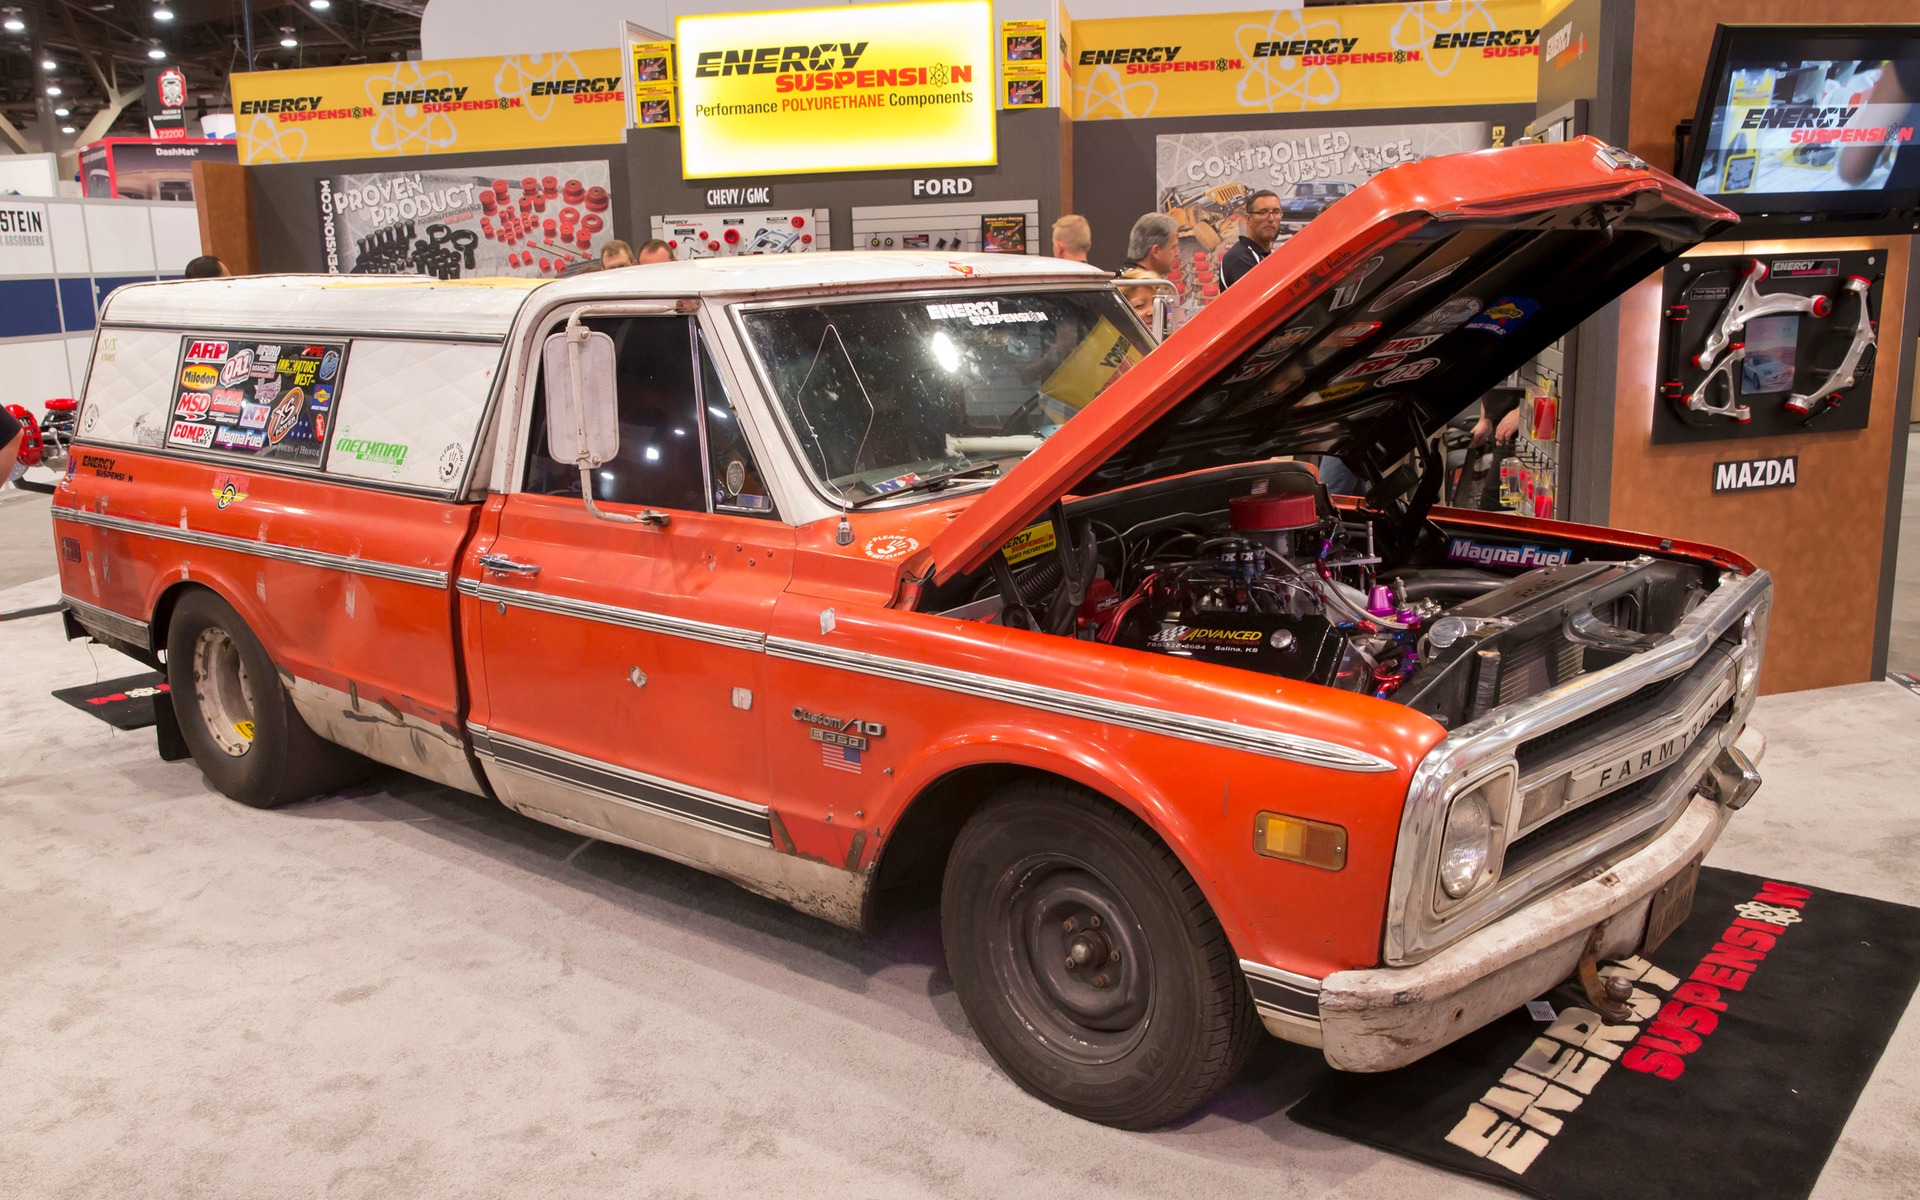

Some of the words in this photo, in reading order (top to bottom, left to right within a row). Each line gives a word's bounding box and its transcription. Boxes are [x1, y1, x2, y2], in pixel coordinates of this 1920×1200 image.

[1252, 37, 1358, 57] ENERGY
[1433, 29, 1540, 49] ENERGY
[695, 42, 869, 78] ENERGY
[1079, 46, 1182, 65] ENERGY
[382, 87, 469, 105] ENERGY
[531, 77, 621, 96] ENERGY
[240, 96, 322, 115] ENERGY
[696, 101, 778, 117] Performance
[782, 94, 885, 112] POLYURETHANE
[889, 90, 973, 108] Components
[1741, 107, 1859, 129] ENERGY
[158, 129, 185, 139] 23200
[1187, 130, 1352, 182] CONTROLLED
[1269, 139, 1415, 188] SUBSTANCE
[333, 173, 424, 215] PROVEN
[707, 188, 740, 206] CHEVY
[746, 187, 770, 204] GMC
[913, 178, 973, 196] FORD
[370, 183, 474, 228] PRODUCT
[4, 234, 45, 247] ABSORBERS
[1773, 261, 1815, 272] ENERGY
[926, 301, 998, 320] ENERGY
[187, 342, 228, 359] ARP
[183, 370, 216, 385] Milodon
[294, 373, 314, 386] WEST
[177, 392, 211, 413] MSD
[173, 423, 205, 440] COMP
[217, 428, 265, 448] MagnaFuel
[336, 438, 409, 458] MECHMAN
[82, 455, 116, 471] ENERGY
[96, 468, 133, 483] SUSPENSIN
[874, 473, 918, 493] NX
[1715, 459, 1796, 490] MAZDA
[1451, 540, 1570, 568] MagnaFuel
[1183, 628, 1262, 641] ADVANCED
[1600, 739, 1675, 787] FARM
